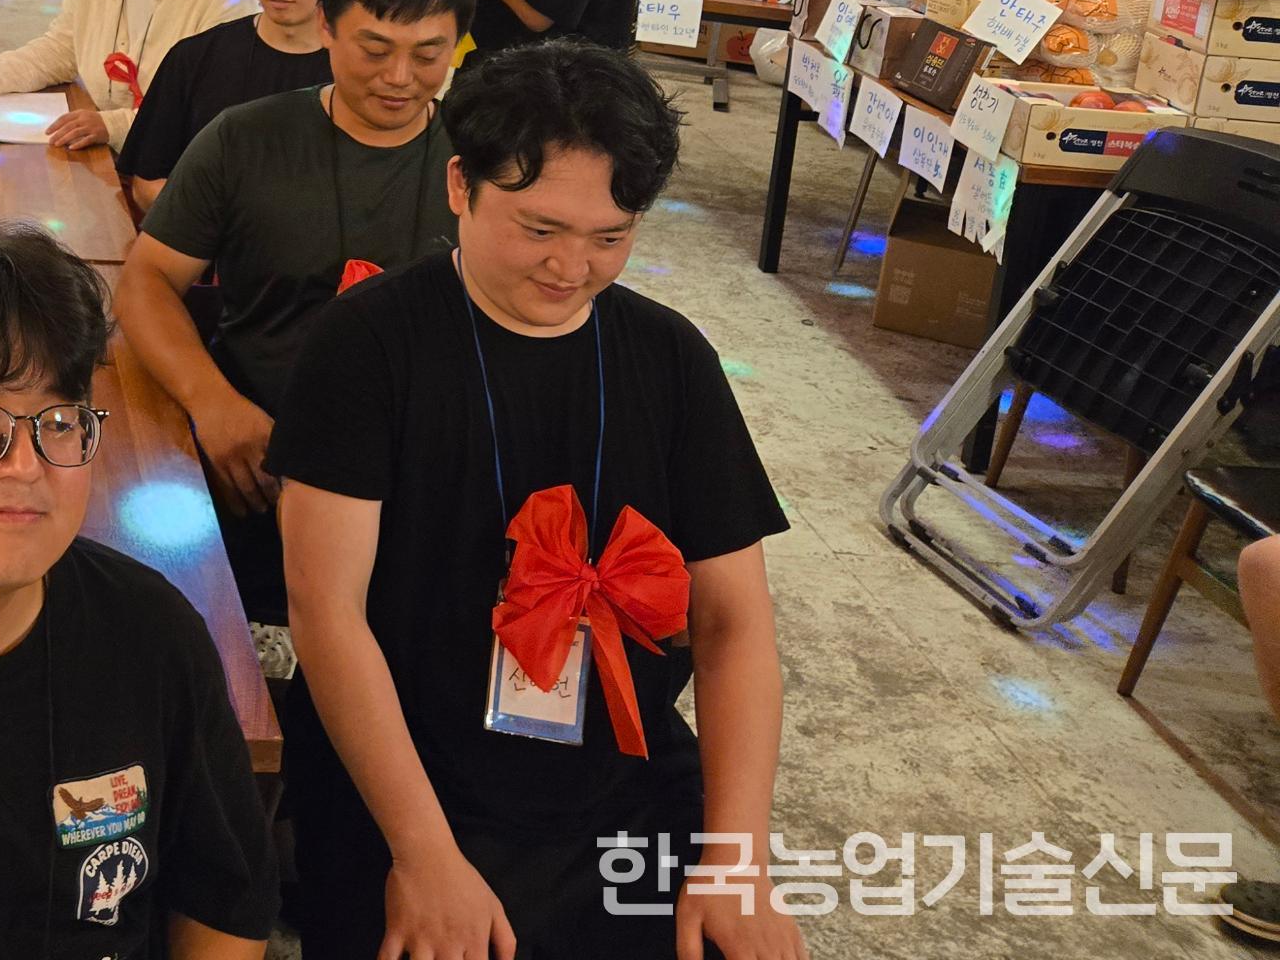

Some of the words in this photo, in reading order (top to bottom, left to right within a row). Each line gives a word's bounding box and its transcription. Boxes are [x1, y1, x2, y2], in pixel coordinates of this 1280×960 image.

[61, 826, 106, 846] WHEREVER
[107, 821, 122, 835] YOU
[85, 841, 121, 878] CARPE
[121, 840, 145, 866] DIEM
